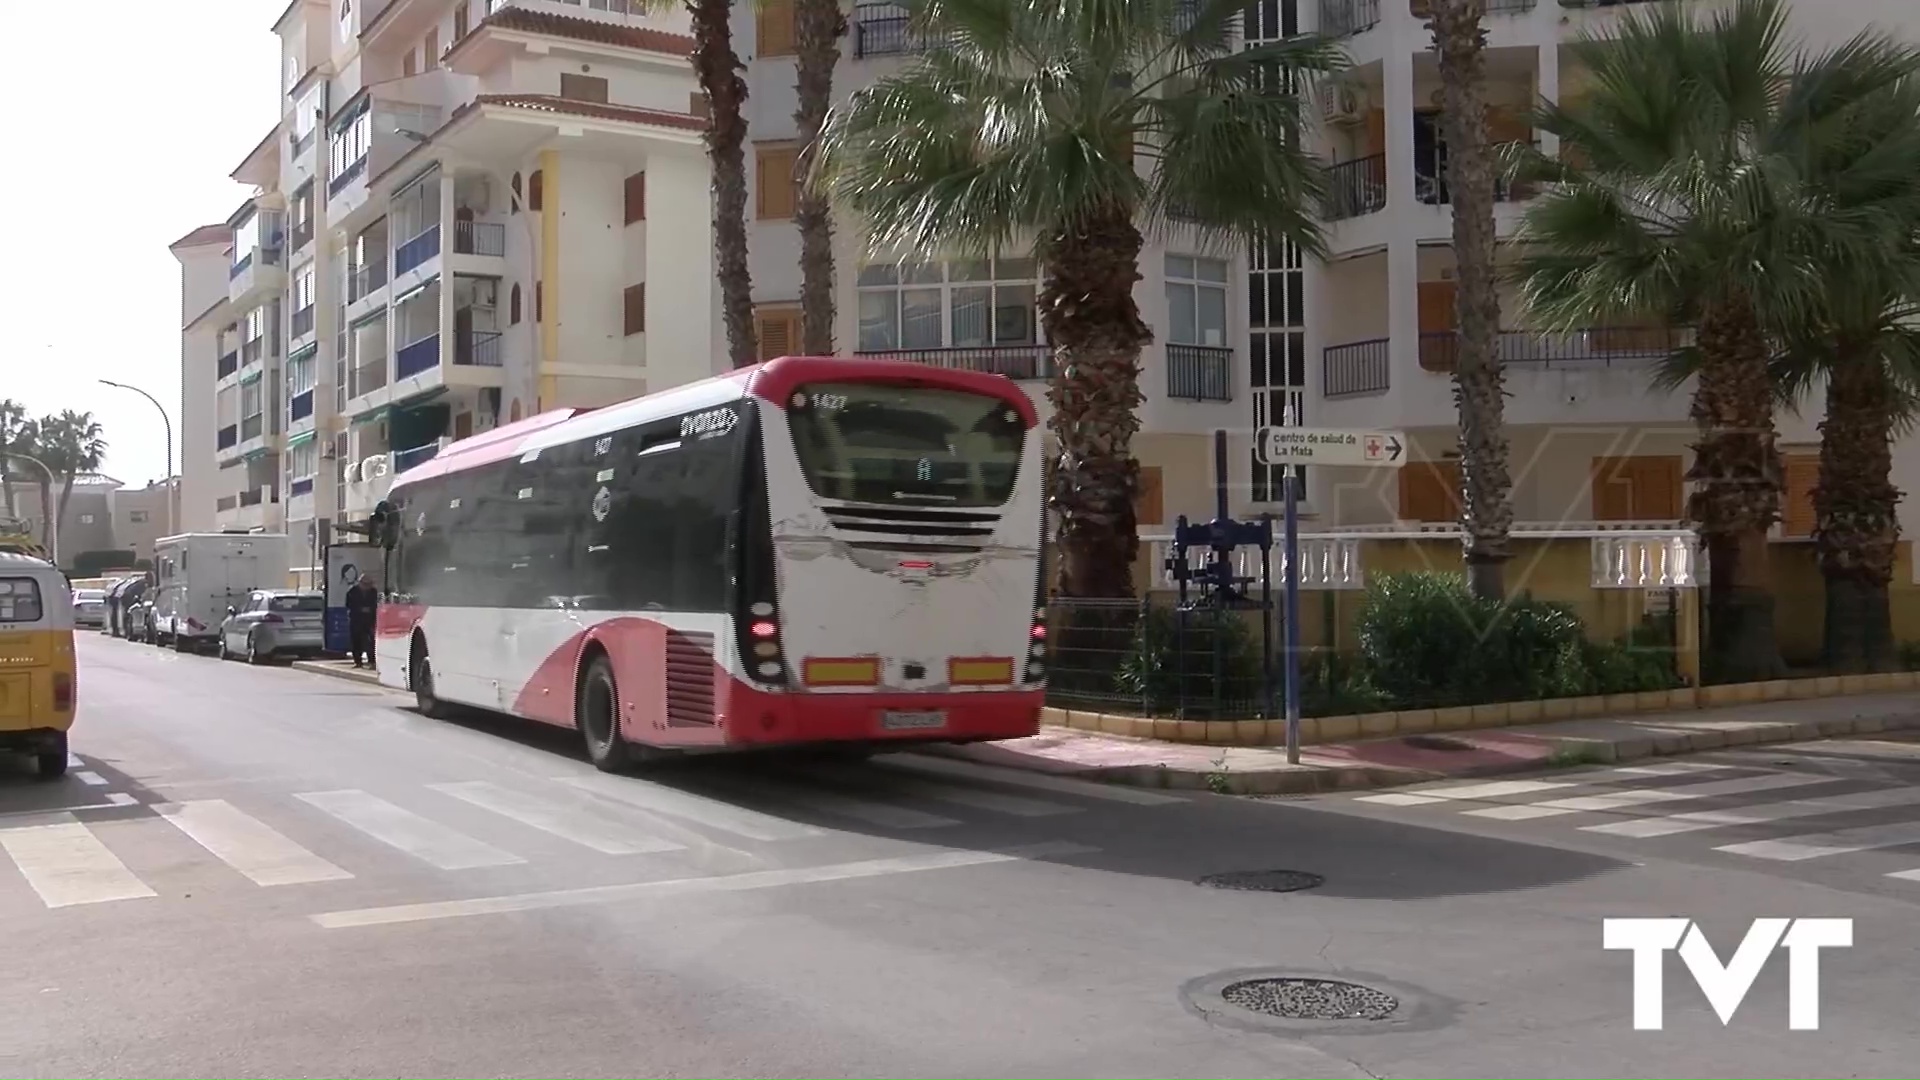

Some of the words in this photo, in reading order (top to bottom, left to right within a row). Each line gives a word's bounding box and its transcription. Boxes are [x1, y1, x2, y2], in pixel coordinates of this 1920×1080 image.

[811, 393, 848, 409] 1427
[680, 408, 728, 438] avanza
[594, 437, 612, 457] 1427
[1308, 433, 1319, 443] de
[1321, 433, 1345, 444] salud
[1346, 434, 1357, 444] de
[1275, 446, 1287, 456] La
[1291, 446, 1314, 457] Mata
[917, 457, 931, 480] A
